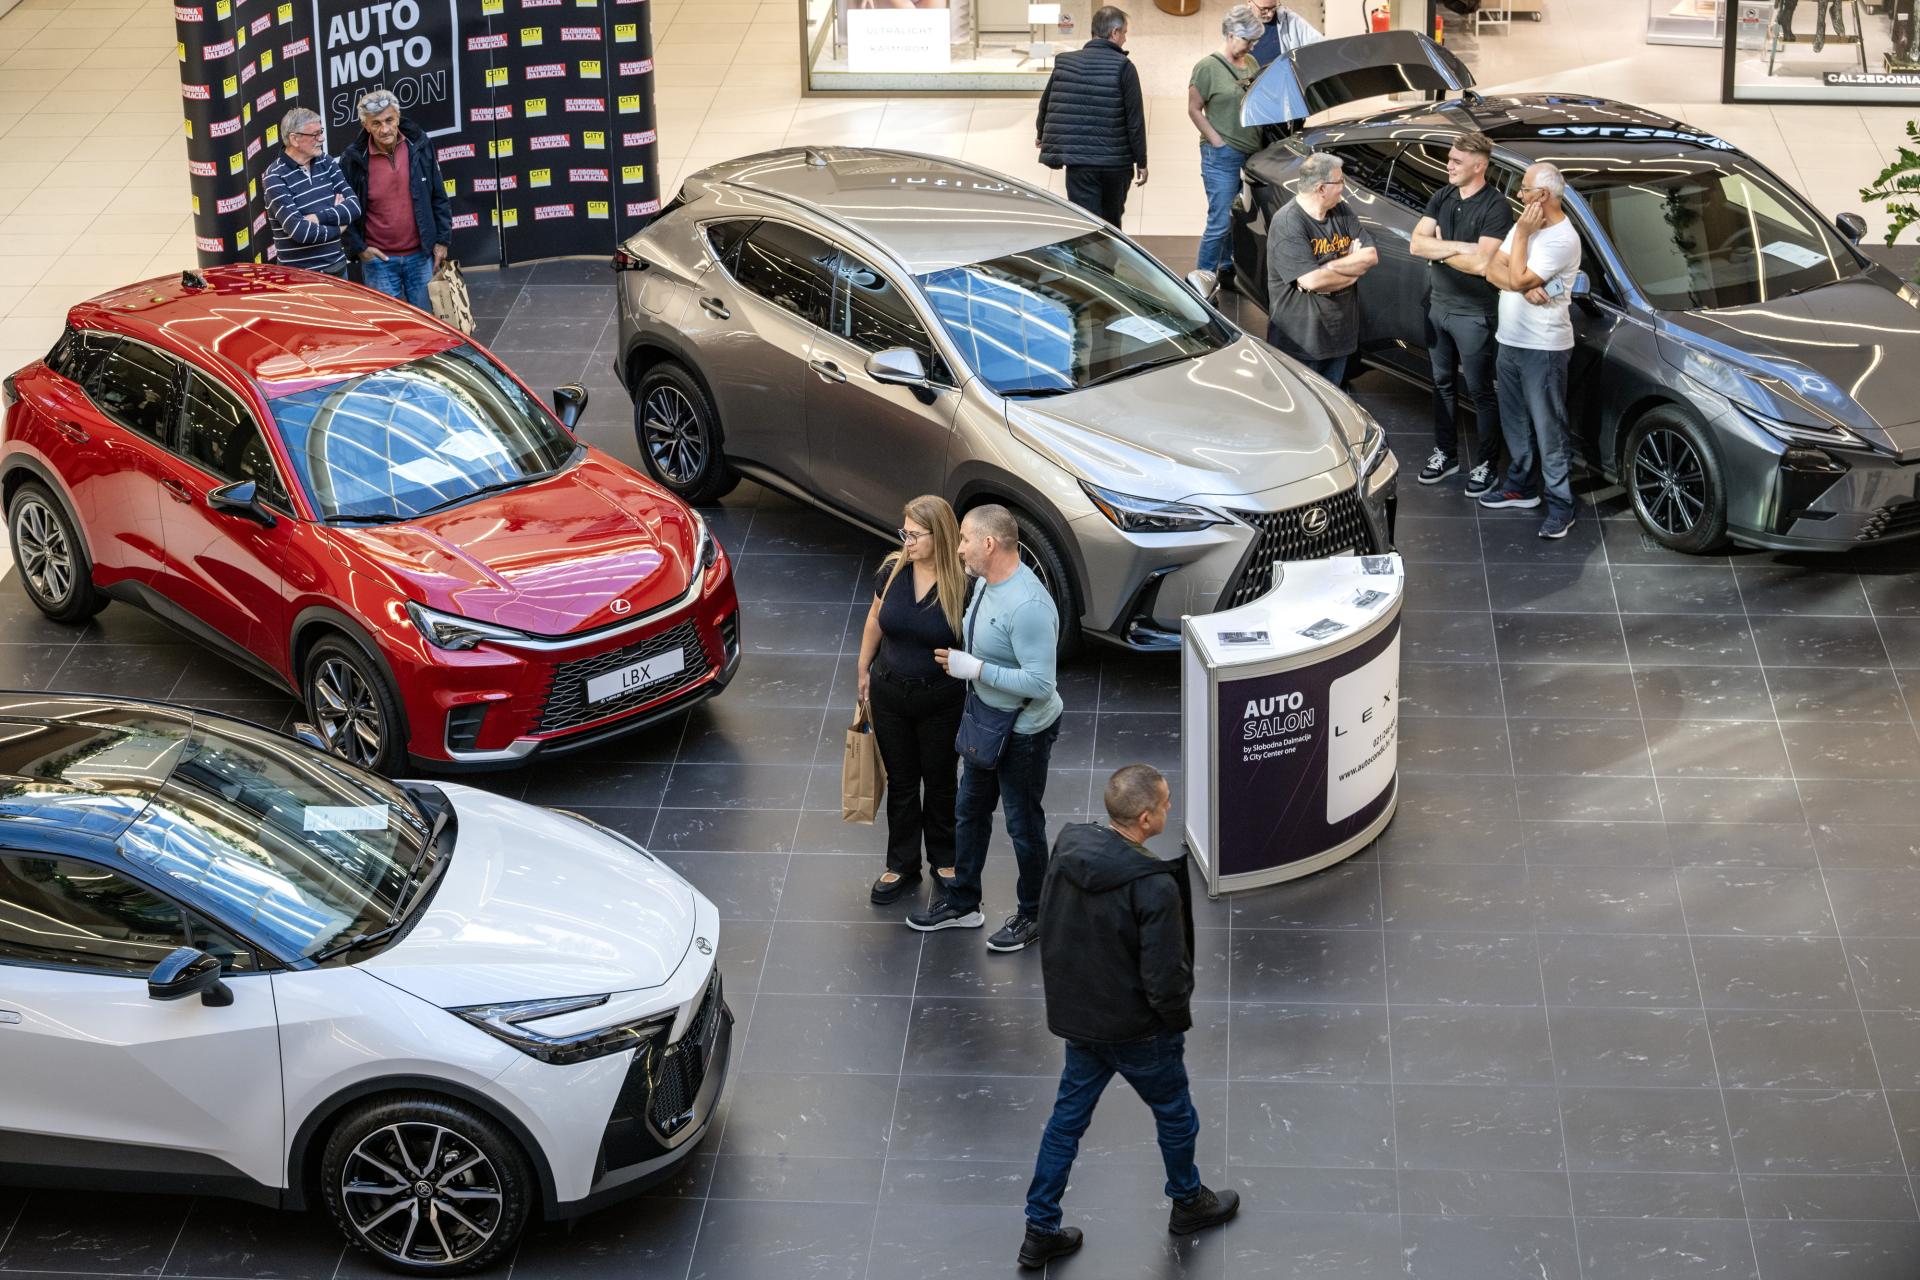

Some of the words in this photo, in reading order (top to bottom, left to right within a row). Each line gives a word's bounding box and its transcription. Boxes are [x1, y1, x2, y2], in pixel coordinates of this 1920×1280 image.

[279, 5, 291, 13] CITY
[328, 0, 420, 49] AUTO
[468, 35, 503, 43] SLOBODNA
[330, 36, 432, 88] MOTO
[527, 65, 561, 73] SLOBODNA
[285, 80, 296, 88] CITY
[1828, 74, 1920, 84] CALZEDONIA
[332, 70, 446, 127] SAON
[530, 134, 565, 143] SLOBODNA
[535, 205, 570, 213] SLOBODNA
[622, 663, 651, 688] LBX
[1244, 692, 1303, 719] AUTO
[1244, 708, 1314, 740] SALON
[1253, 741, 1282, 751] Slobodna
[1284, 734, 1311, 745] Dalmacija
[1263, 750, 1283, 758] Center
